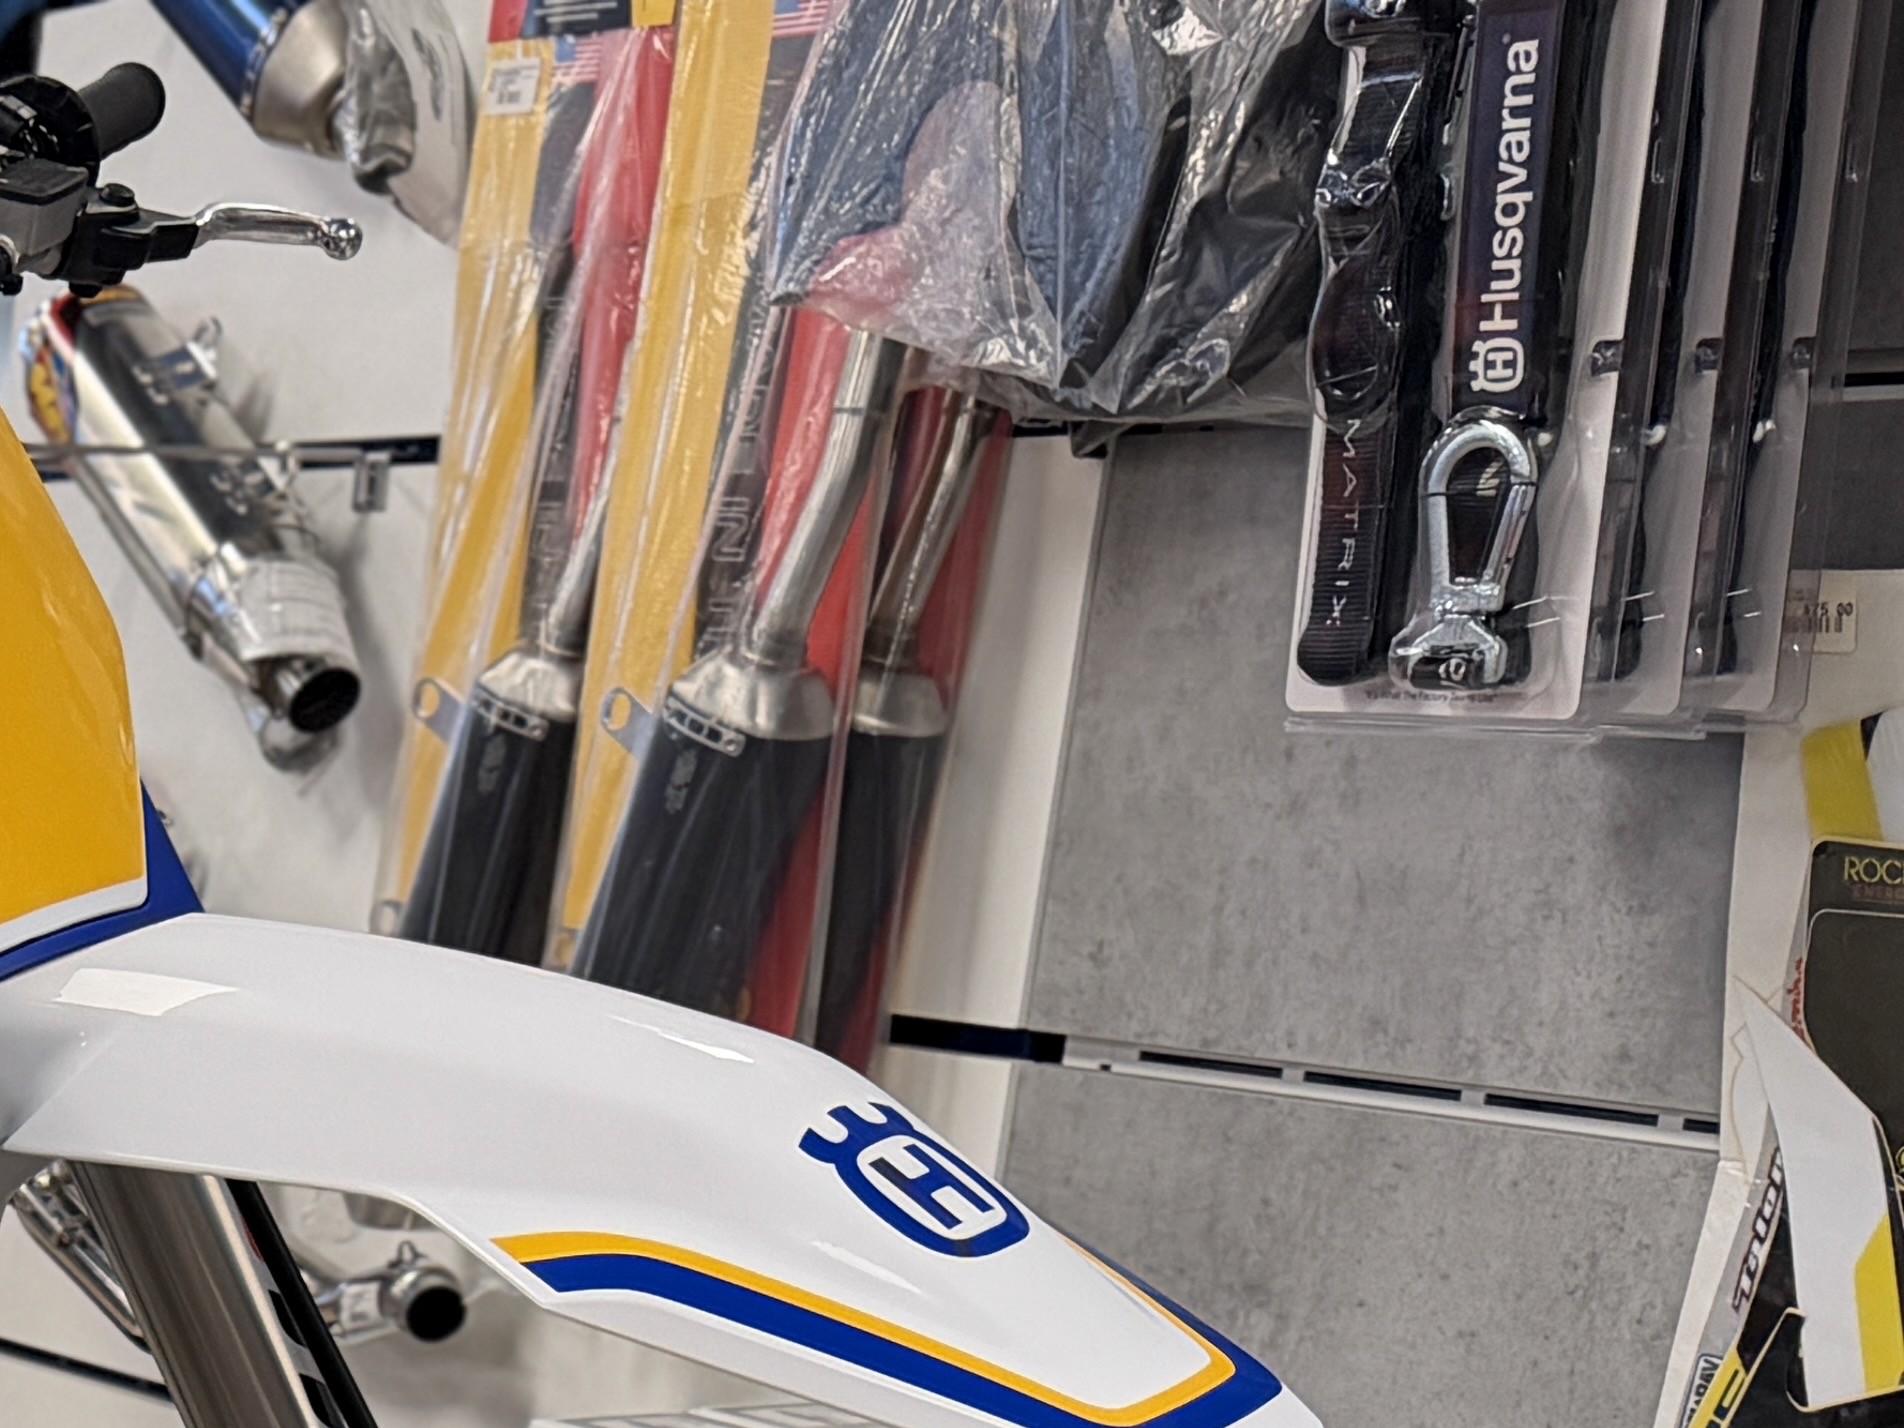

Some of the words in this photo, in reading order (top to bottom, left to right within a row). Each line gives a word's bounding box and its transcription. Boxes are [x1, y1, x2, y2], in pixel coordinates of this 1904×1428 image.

[1478, 38, 1540, 333] Husqvarna
[1325, 418, 1362, 626] MATRIX
[1843, 855, 1904, 885] ROC
